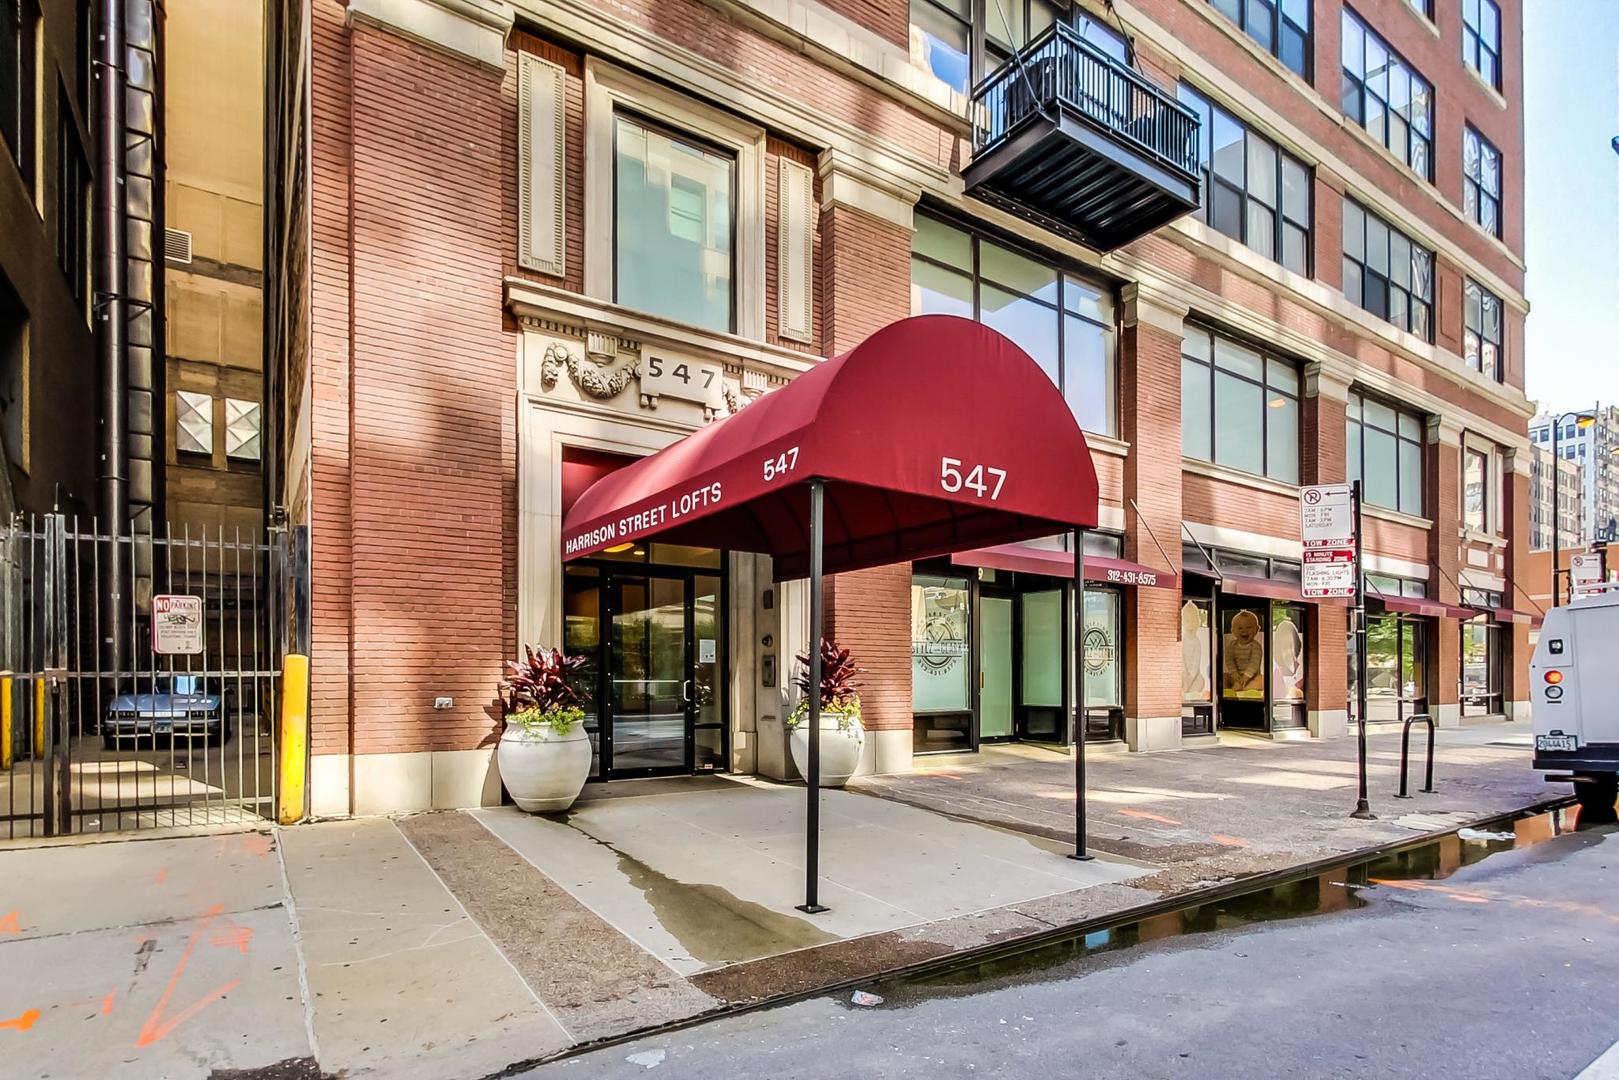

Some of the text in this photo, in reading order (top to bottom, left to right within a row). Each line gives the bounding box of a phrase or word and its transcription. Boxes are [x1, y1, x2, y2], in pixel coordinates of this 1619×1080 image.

[648, 356, 715, 389] 547
[763, 446, 799, 481] 547
[941, 456, 1007, 500] 547
[566, 481, 722, 554] HARRISON STREET LOFTS
[1107, 569, 1156, 586] 312-431-8575
[157, 599, 170, 611] NO
